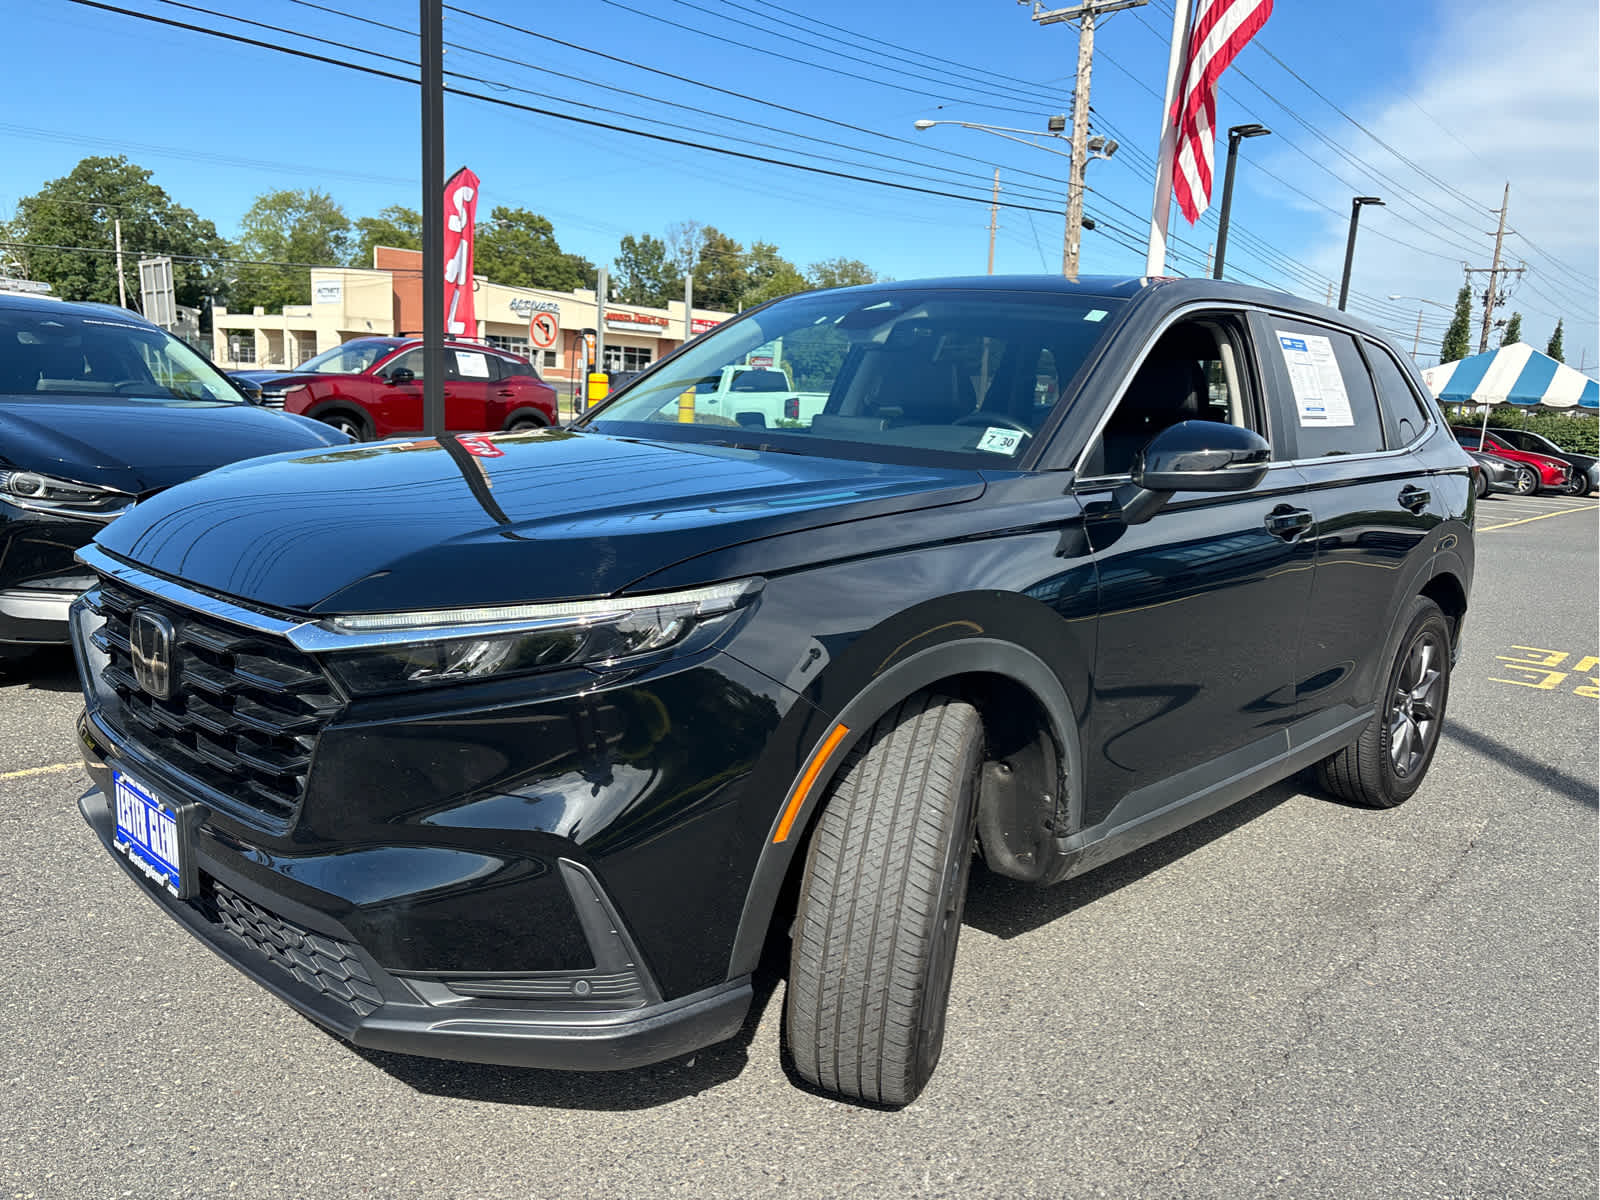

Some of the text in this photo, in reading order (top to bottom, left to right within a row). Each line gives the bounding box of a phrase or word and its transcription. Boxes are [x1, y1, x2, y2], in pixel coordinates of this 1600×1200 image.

[445, 186, 474, 335] SAL
[987, 435, 1015, 447] 7 30
[115, 783, 148, 847] LESTER
[148, 808, 180, 869] GLENN
